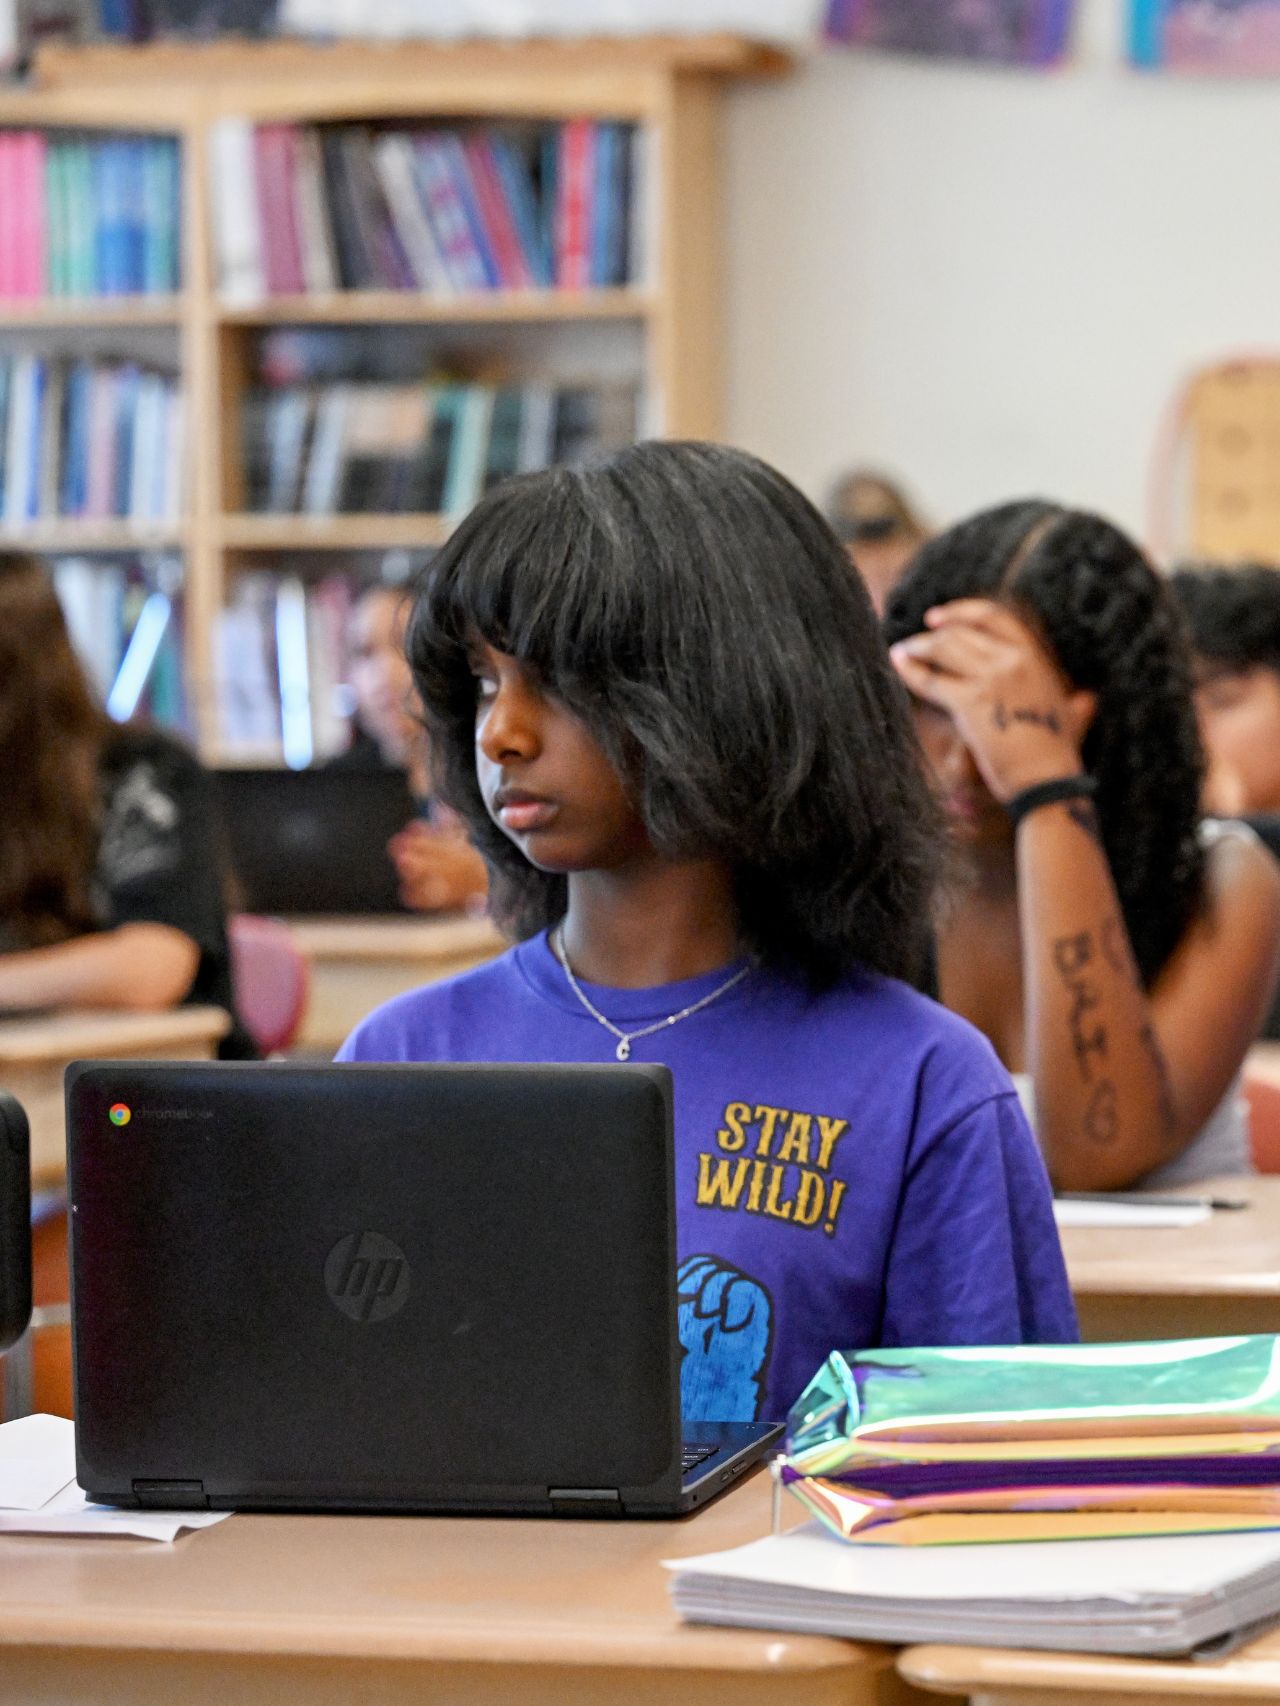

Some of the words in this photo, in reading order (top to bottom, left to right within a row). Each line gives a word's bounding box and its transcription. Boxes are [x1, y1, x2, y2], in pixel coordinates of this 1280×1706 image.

[136, 1103, 214, 1120] chromebok
[717, 1101, 849, 1170] STAY
[696, 1152, 847, 1235] WILD!
[335, 1232, 404, 1320] hp
